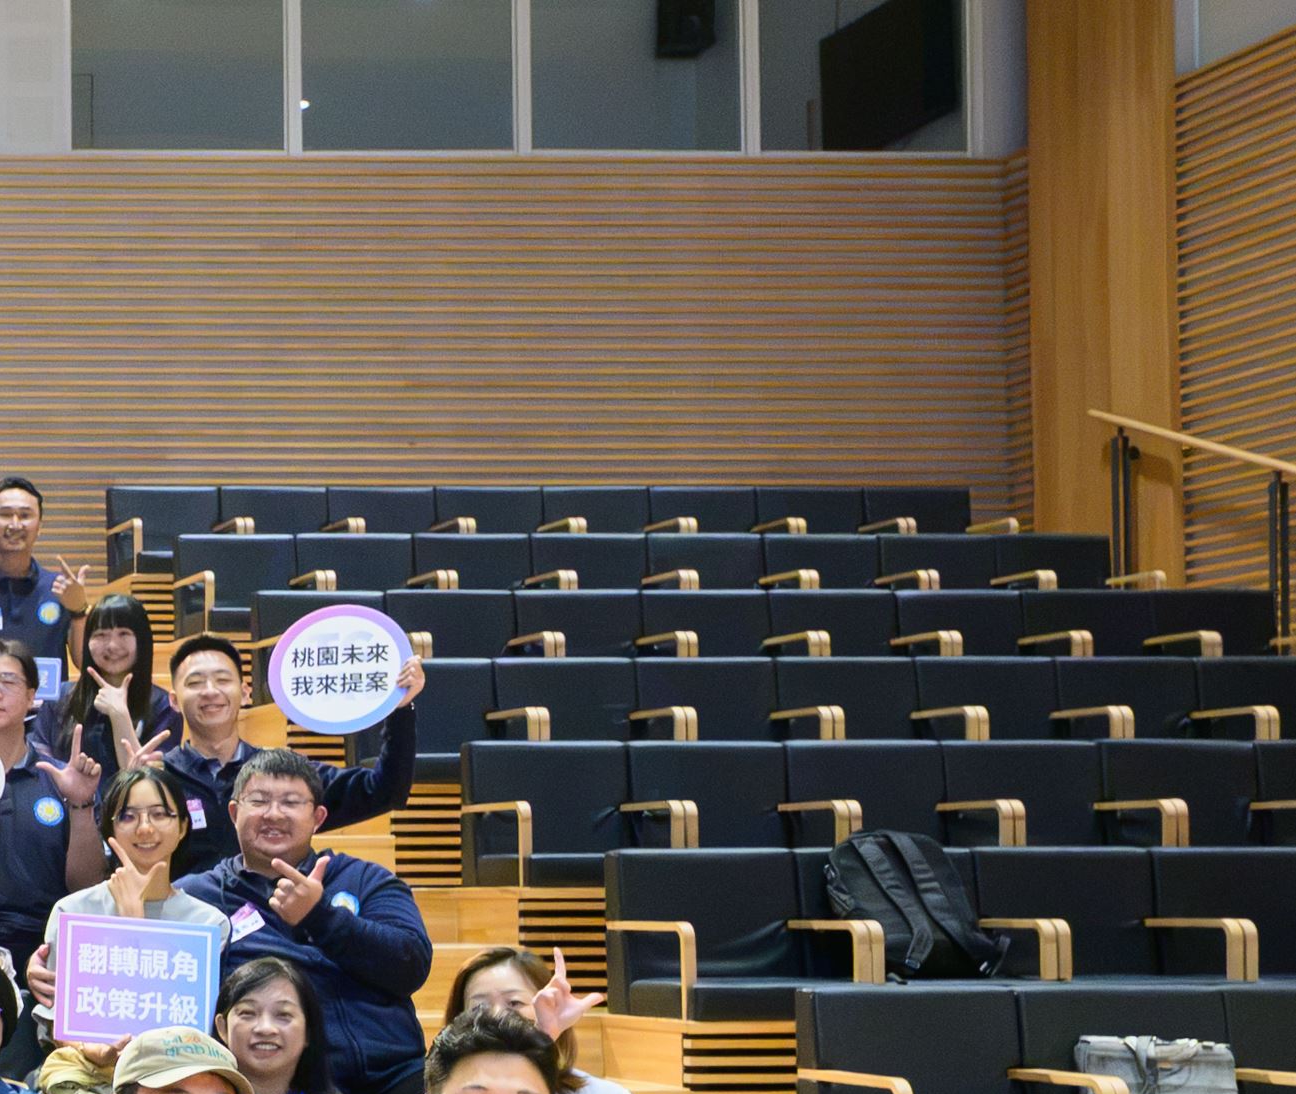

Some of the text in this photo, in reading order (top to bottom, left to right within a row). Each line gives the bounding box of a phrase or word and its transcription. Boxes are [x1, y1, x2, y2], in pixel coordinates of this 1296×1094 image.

[291, 643, 389, 668] 桃園未來
[291, 671, 389, 697] 我來提案
[78, 942, 199, 983] 翻轉視角
[75, 986, 199, 1026] 政策升級
